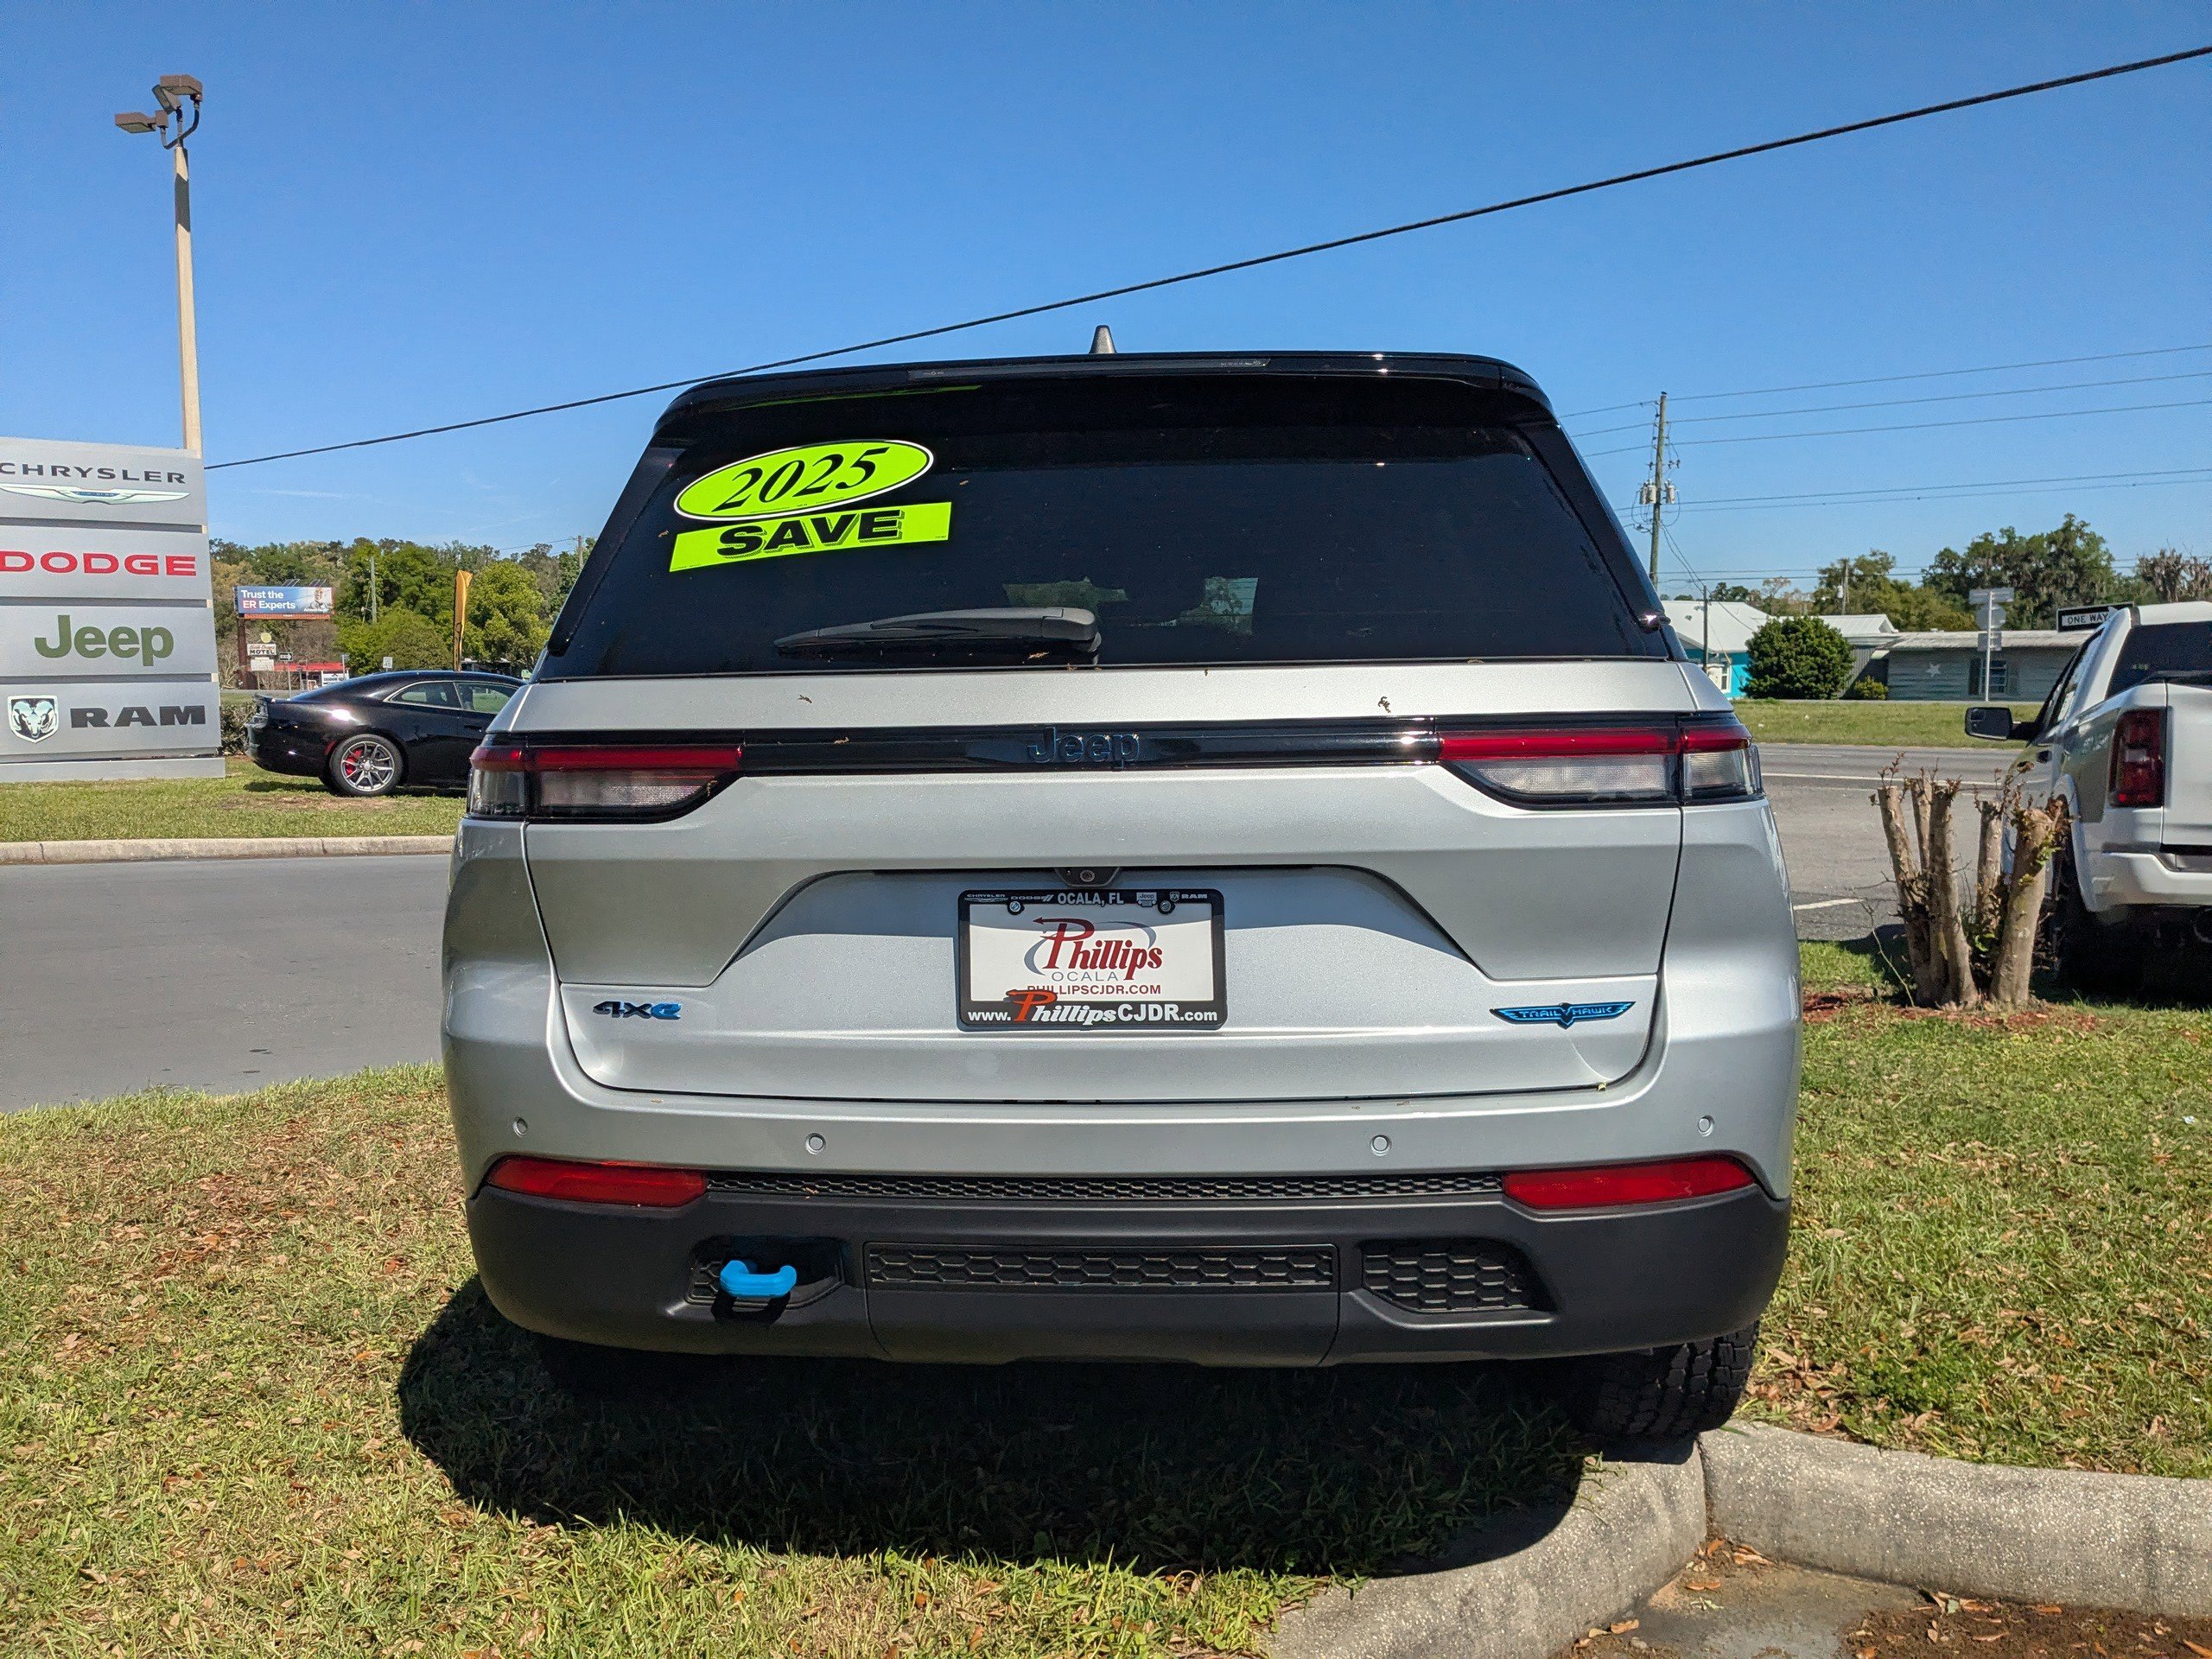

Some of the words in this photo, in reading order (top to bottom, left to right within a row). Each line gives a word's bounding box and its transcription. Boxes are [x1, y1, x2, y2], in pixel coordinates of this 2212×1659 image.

[0, 462, 186, 484] CHRYSLER
[711, 446, 891, 512] 2025
[716, 509, 906, 559] SAVE
[0, 550, 197, 576] DODGE
[241, 589, 266, 599] Trust
[268, 590, 284, 599] the
[258, 601, 296, 610] Experts
[2068, 615, 2086, 624] ONE
[2089, 613, 2108, 622] WAY
[35, 614, 174, 666] Jeep
[71, 705, 207, 728] RAM
[1027, 726, 1140, 770] Jeep
[1057, 893, 1106, 906] OCALA,
[1109, 893, 1124, 904] FL
[1033, 917, 1163, 981] Phillips
[1052, 971, 1119, 982] OCALA
